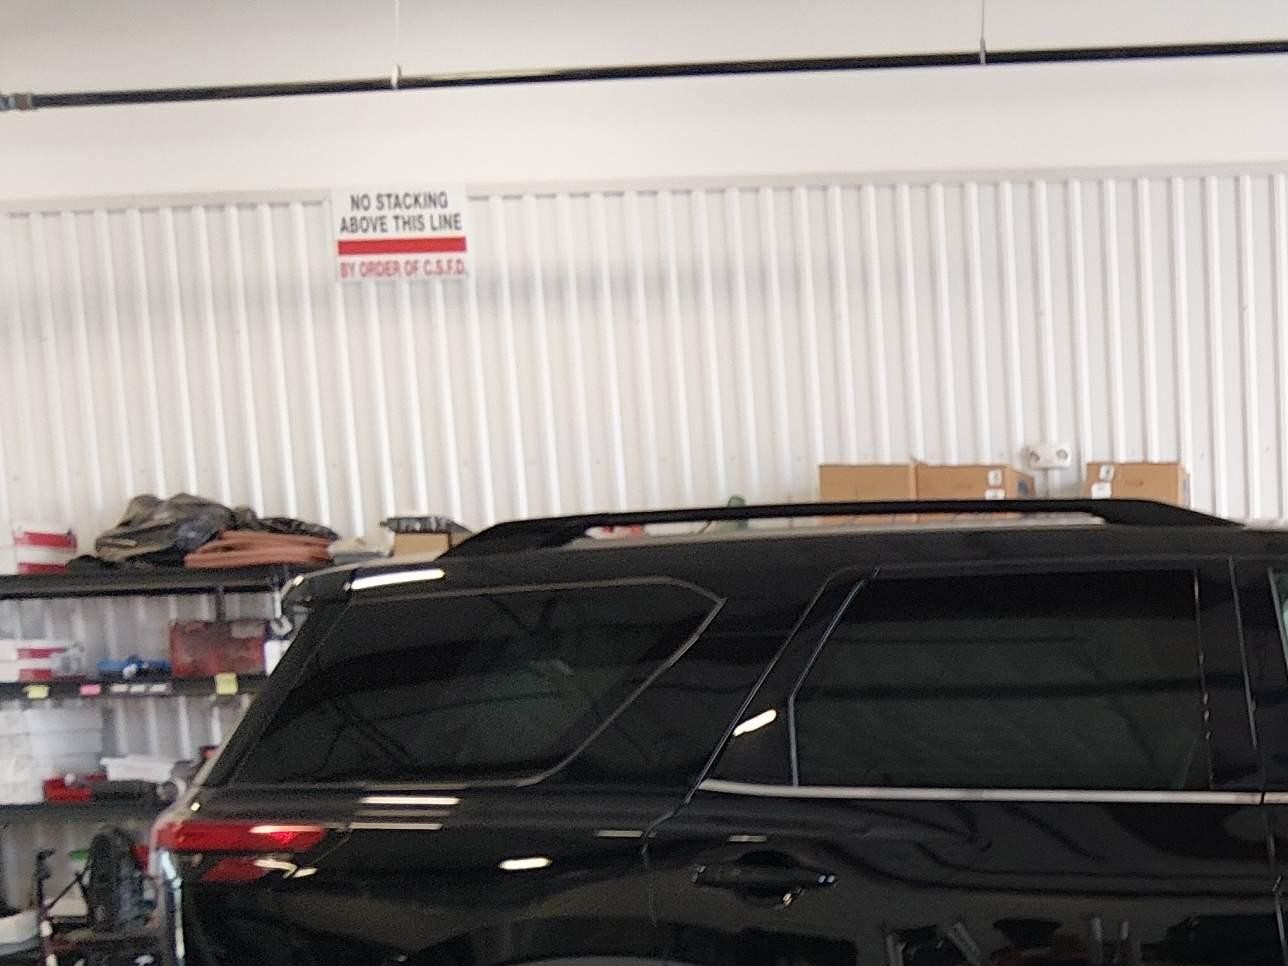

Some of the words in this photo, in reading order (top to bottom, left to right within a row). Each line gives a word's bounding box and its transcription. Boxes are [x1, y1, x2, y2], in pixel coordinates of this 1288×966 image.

[350, 194, 371, 211] NO
[375, 191, 448, 211] STACKING
[340, 215, 388, 233] ABOVE
[393, 214, 425, 232] THIS
[430, 213, 462, 231] LINE
[340, 262, 355, 278] BY
[359, 260, 400, 278] ORDER
[404, 260, 419, 277] OF
